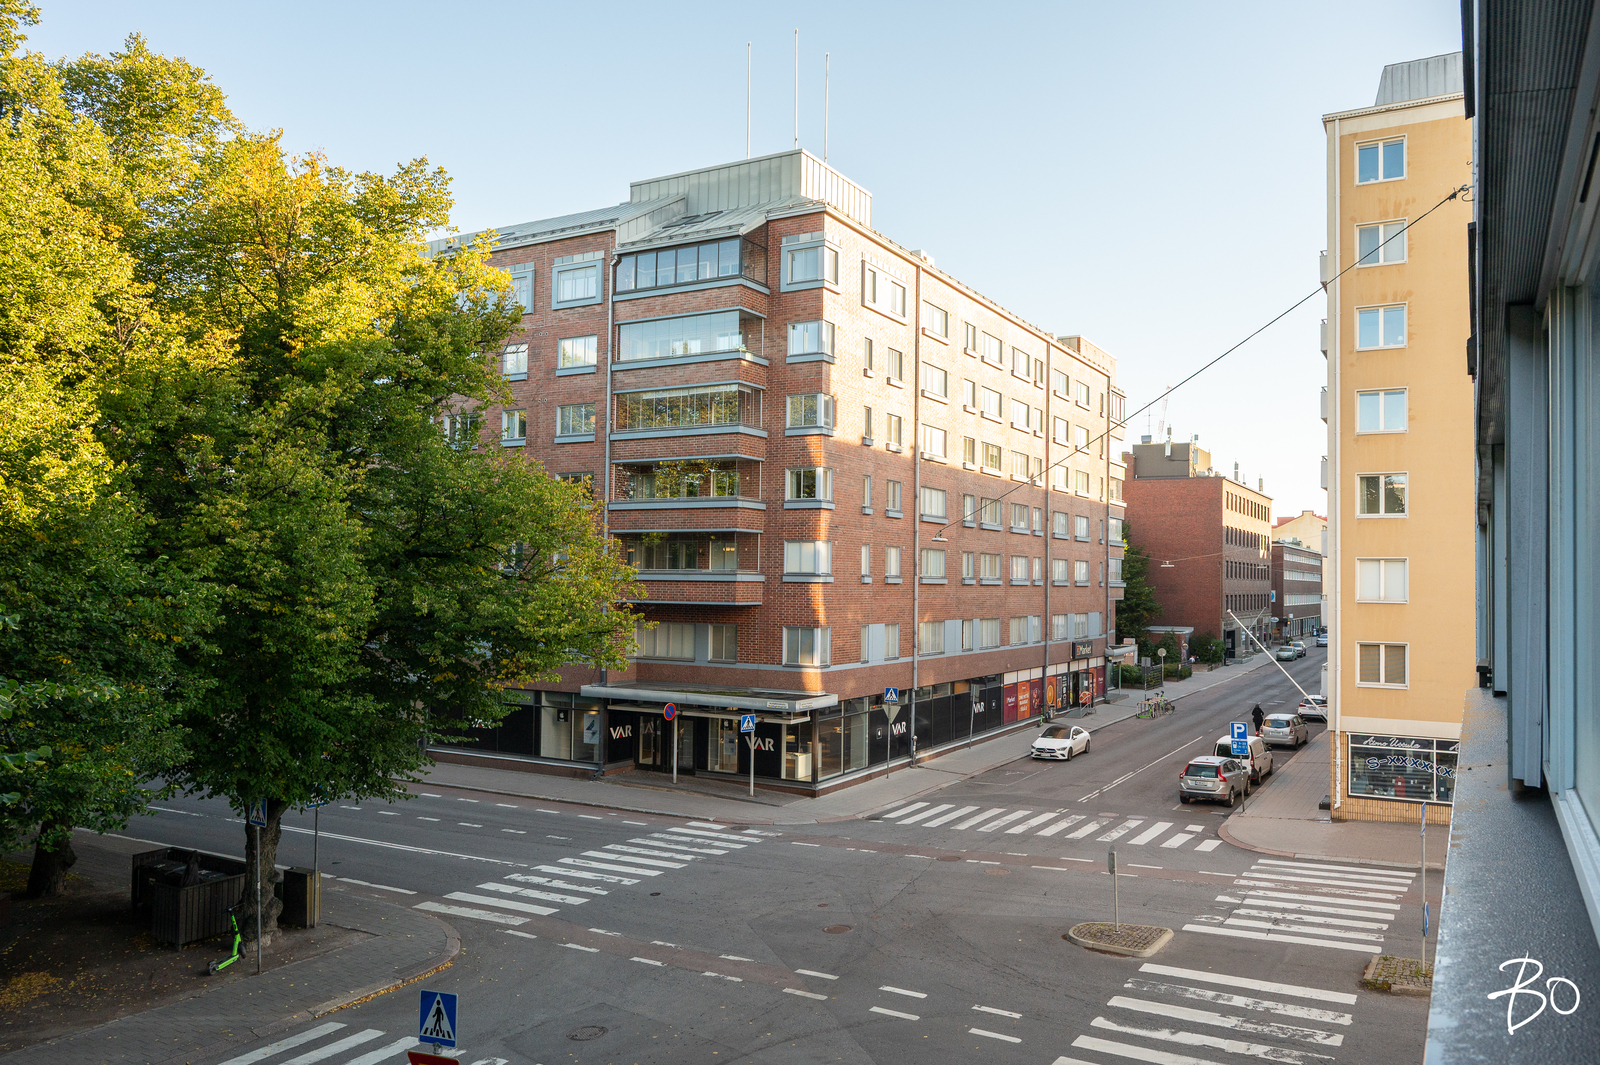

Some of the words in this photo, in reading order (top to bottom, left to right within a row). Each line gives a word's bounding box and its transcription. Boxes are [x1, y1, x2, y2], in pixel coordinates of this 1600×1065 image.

[609, 724, 632, 740] VAR
[891, 721, 907, 735] VAR
[1233, 723, 1245, 738] P
[744, 735, 775, 752] VAR
